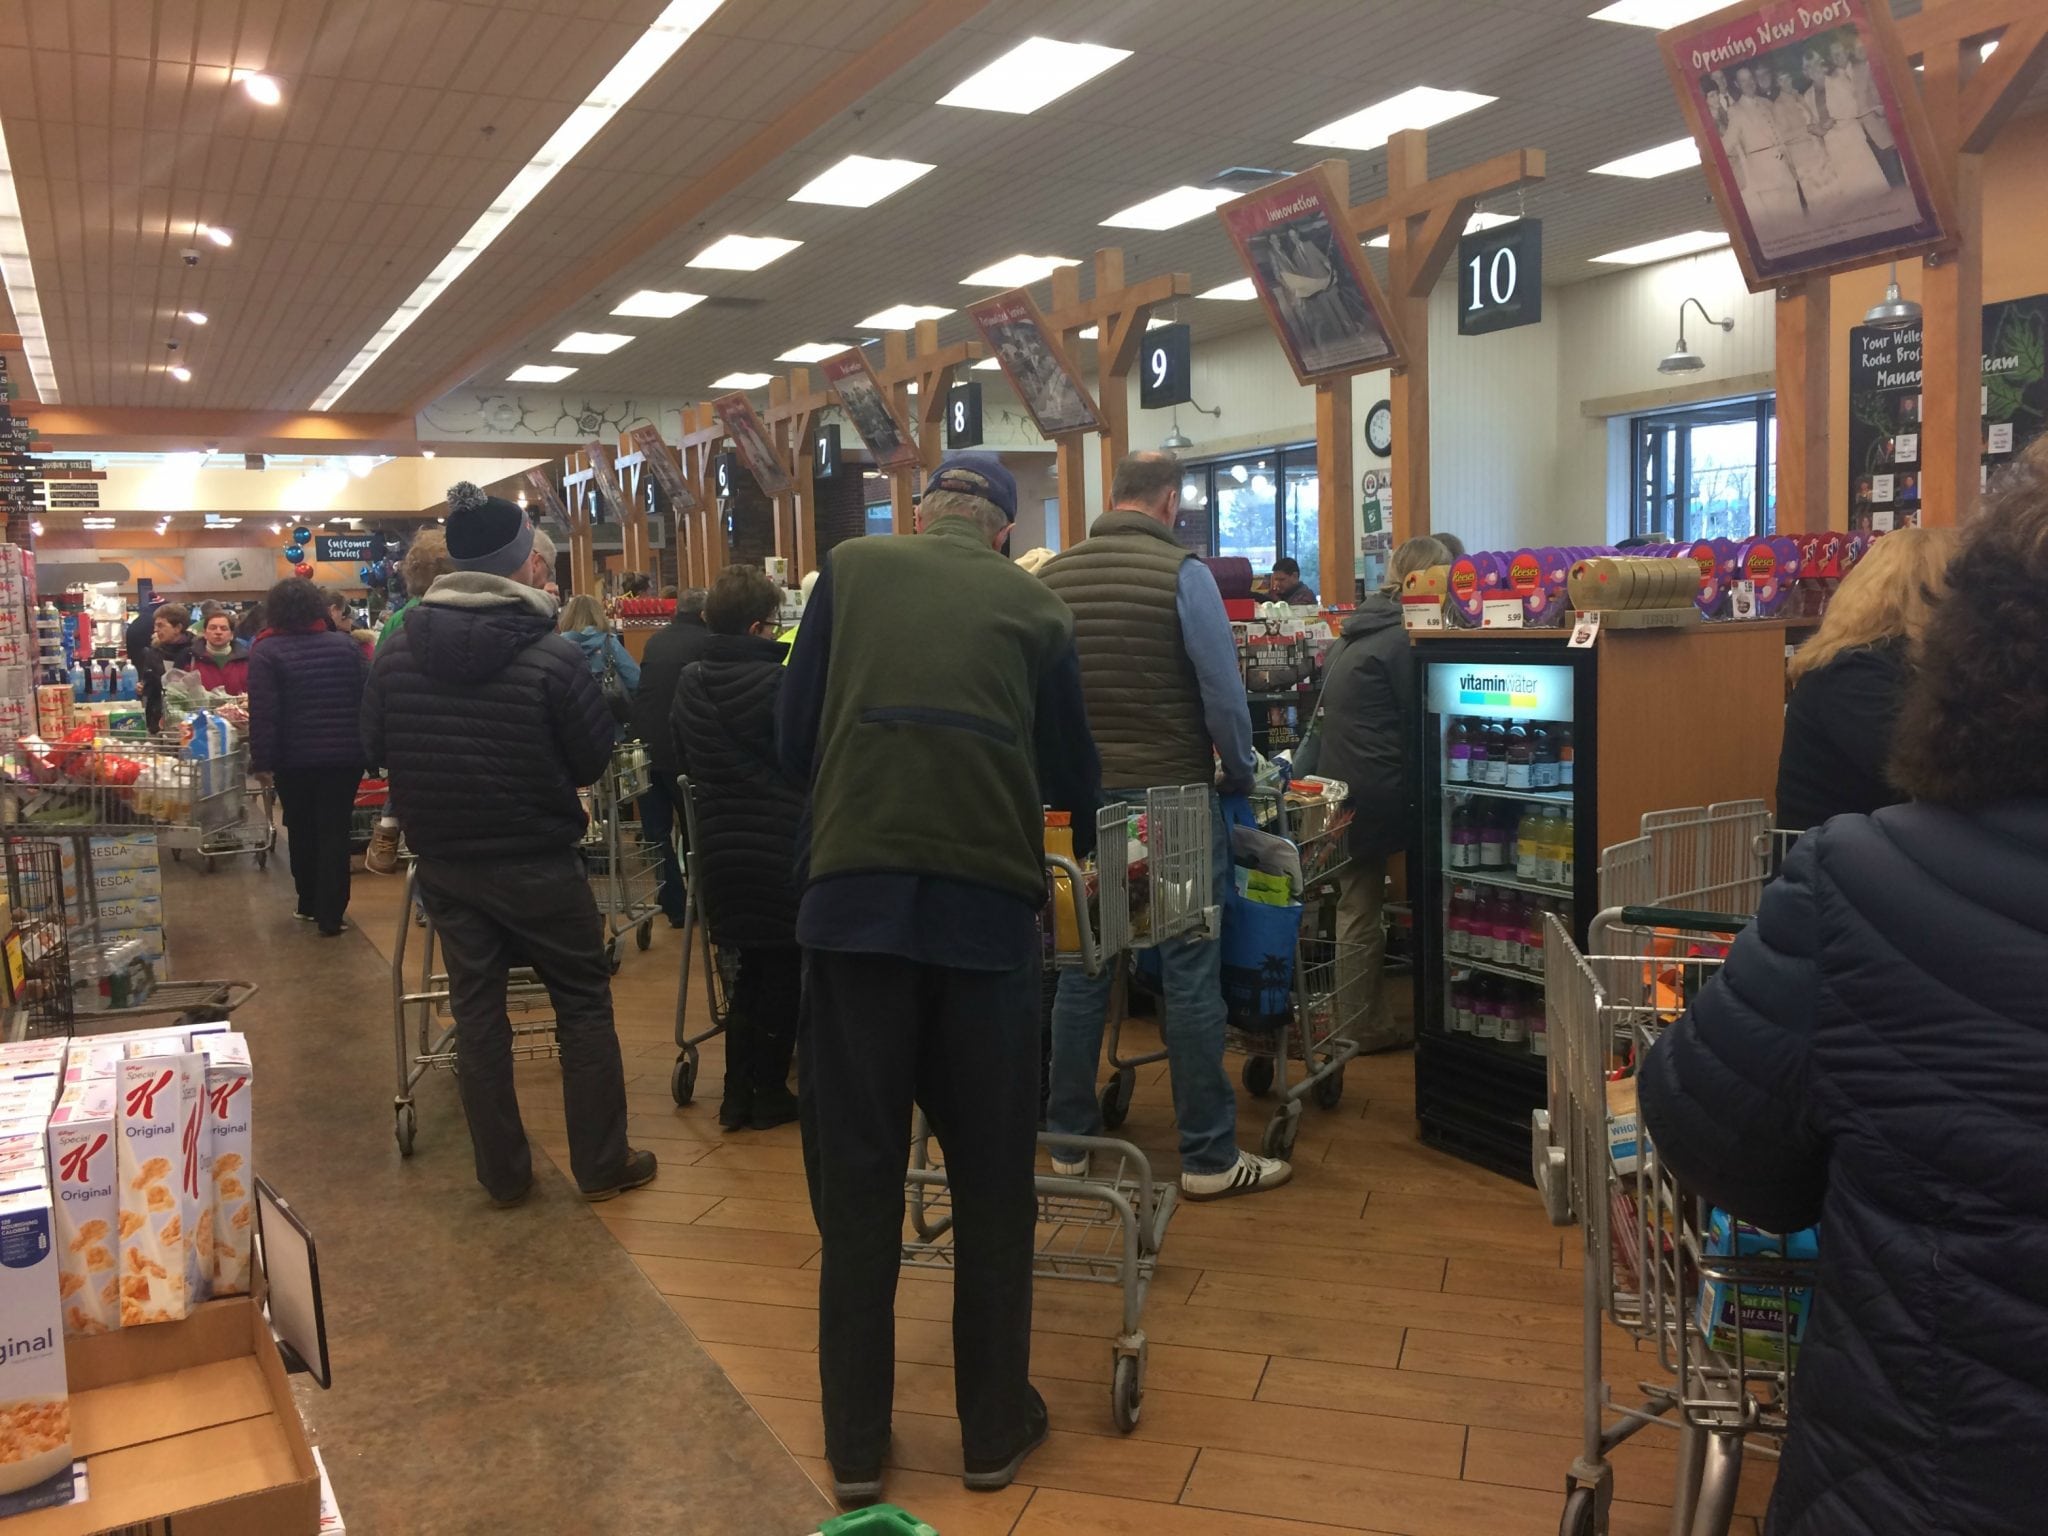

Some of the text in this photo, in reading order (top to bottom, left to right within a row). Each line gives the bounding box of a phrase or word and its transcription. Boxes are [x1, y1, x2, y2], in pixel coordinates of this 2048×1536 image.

[1692, 0, 1851, 72] Opening New Doors
[1265, 194, 1319, 222] Innovation
[1468, 247, 1517, 311] 10
[1862, 336, 1889, 350] Your
[1862, 347, 1923, 367] Roche Bros.
[1152, 348, 1167, 389] 9
[1877, 369, 1922, 388] Manag
[954, 401, 965, 433] 8
[819, 438, 827, 465] 7
[718, 463, 726, 487] 6
[647, 484, 653, 504] 5
[0, 503, 43, 512] ravy/Potato
[327, 538, 371, 550] Customer
[328, 549, 360, 559] Services
[1427, 618, 1440, 627] 6.99
[1507, 612, 1522, 622] 5.99
[1460, 673, 1538, 693] vitaminwater
[90, 846, 128, 858] RESCA
[95, 876, 131, 888] RESCA
[126, 1070, 174, 1119] K
[211, 1076, 247, 1119] K
[126, 1122, 175, 1138] Original
[212, 1122, 248, 1137] riginal
[60, 1133, 109, 1182] K
[61, 1185, 111, 1201] Original
[1768, 1310, 1794, 1324] Haf
[0, 1327, 53, 1366] ginal
